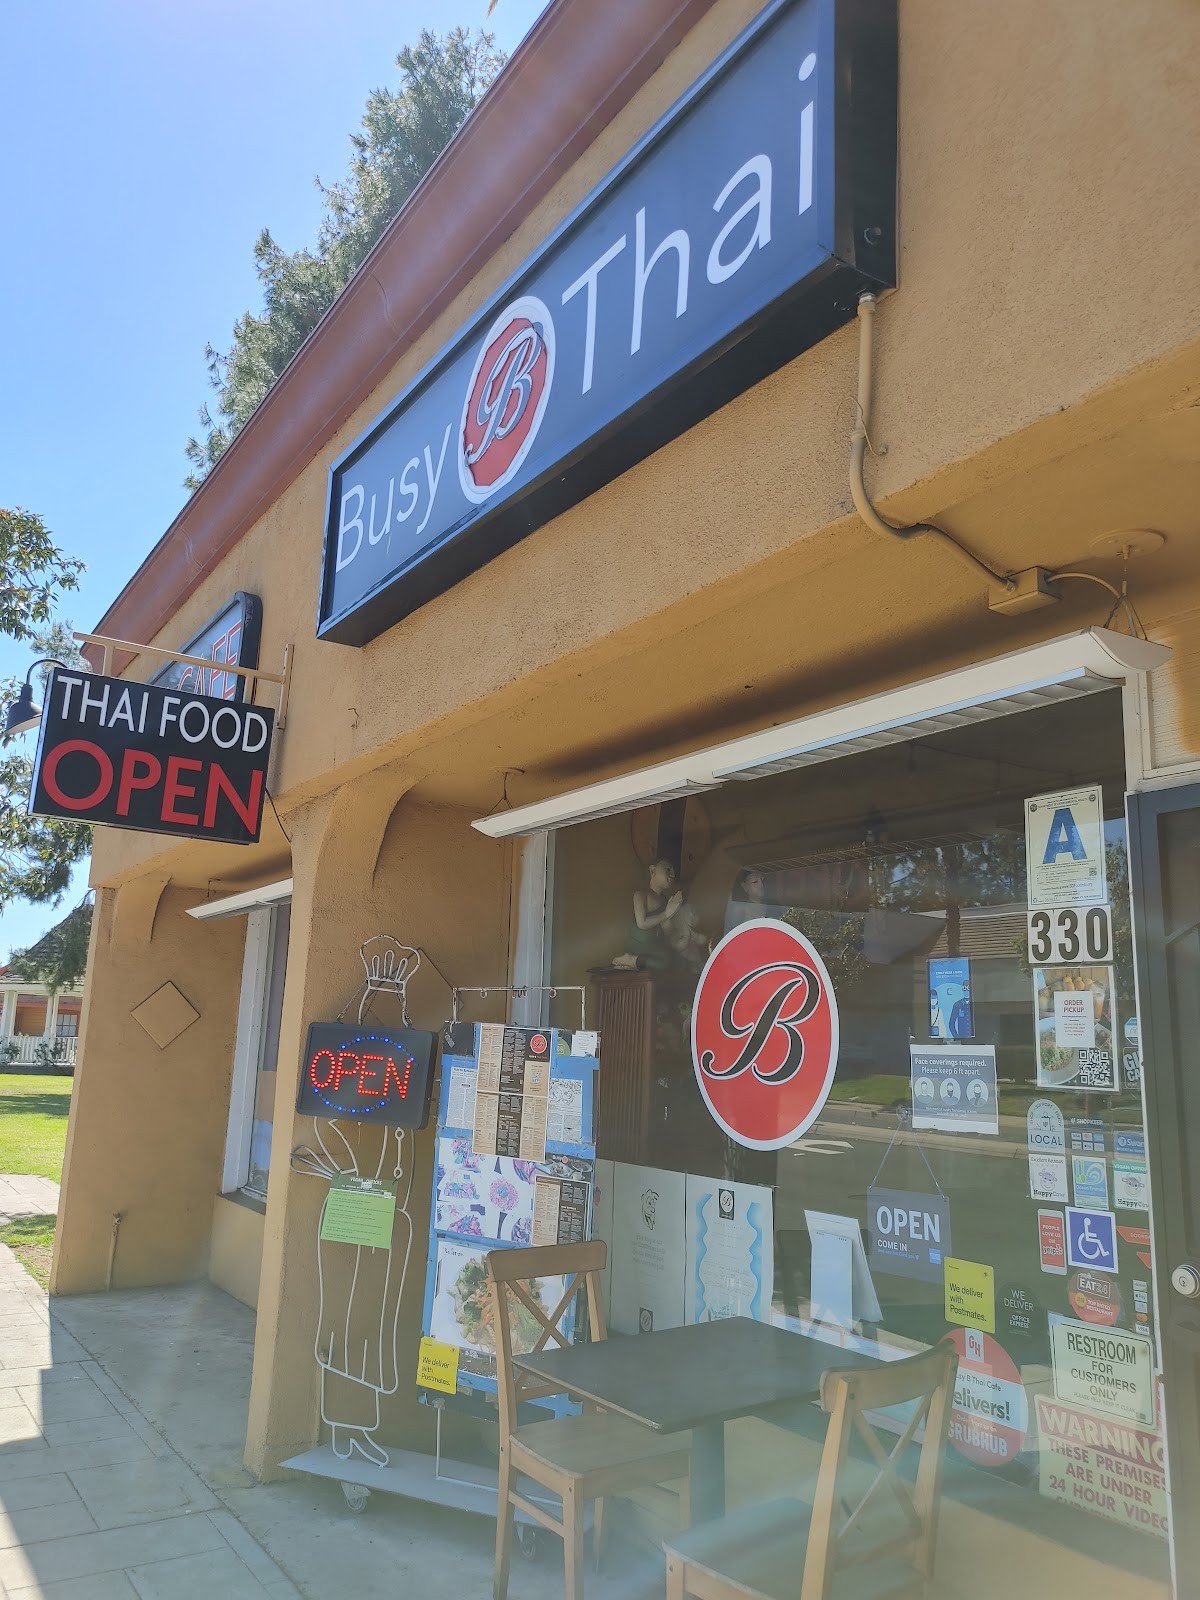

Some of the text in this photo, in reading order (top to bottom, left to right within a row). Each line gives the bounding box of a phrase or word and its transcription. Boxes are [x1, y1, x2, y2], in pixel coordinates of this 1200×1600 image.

[335, 423, 452, 573] Busy
[561, 51, 817, 397] Thai
[57, 675, 268, 753] THAI FOOD
[42, 739, 264, 836] OPEN
[1042, 807, 1088, 865] A
[1030, 907, 1109, 962] 330
[914, 1057, 987, 1068] Face coverings required.
[921, 1066, 938, 1074] Please
[939, 1067, 953, 1075] keep
[953, 1067, 958, 1075] 6
[958, 1067, 964, 1075] ft
[310, 1050, 412, 1100] OPEN
[1030, 1134, 1063, 1146] LOCAL
[876, 1205, 941, 1243] OPEN
[877, 1239, 908, 1252] COME IN
[949, 1283, 984, 1299] We deliver
[1011, 1288, 1026, 1300] WE
[1079, 1279, 1109, 1295] EAT24
[949, 1295, 964, 1305] with
[1004, 1298, 1034, 1312] DELIVER
[950, 1304, 987, 1322] Postmates.
[1011, 1314, 1030, 1324] OFFICE
[1009, 1319, 1029, 1329] EXPRESS
[1067, 1332, 1137, 1365] RESTROOM
[431, 1358, 450, 1369] deliver
[1091, 1360, 1114, 1375] FOR
[971, 1376, 986, 1386] Thai
[986, 1381, 1002, 1392] Cafe
[1070, 1368, 1137, 1394] CUSTOMERS
[1089, 1385, 1118, 1401] ONLY
[953, 1387, 1010, 1421] elivers!
[947, 1421, 1008, 1457] GRUBHUB
[1048, 1438, 1089, 1464] THESE
[1065, 1462, 1152, 1506] ARE UNDER
[1049, 1474, 1066, 1493] 24
[1073, 1482, 1116, 1512] HOUR
